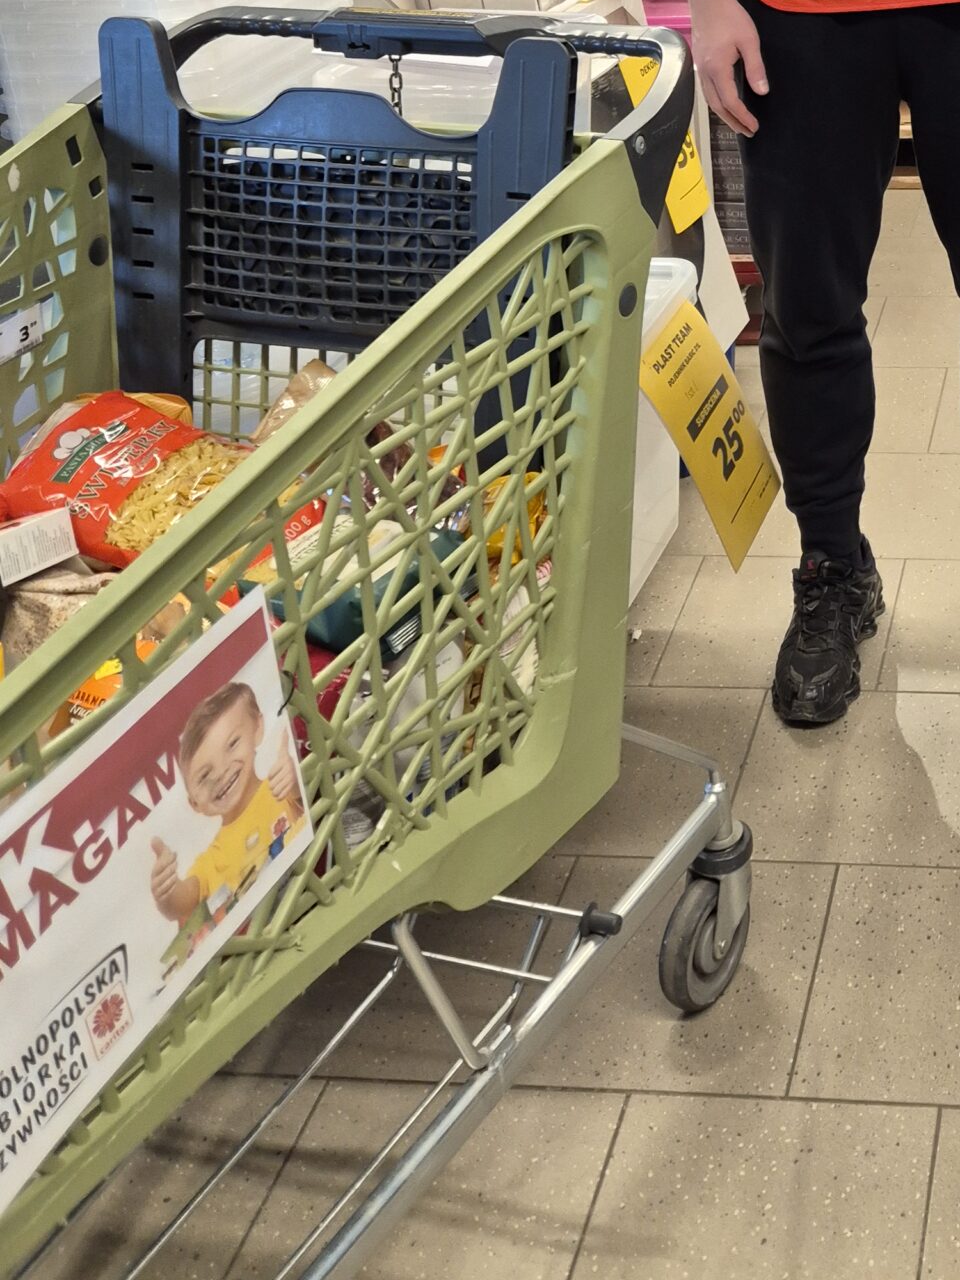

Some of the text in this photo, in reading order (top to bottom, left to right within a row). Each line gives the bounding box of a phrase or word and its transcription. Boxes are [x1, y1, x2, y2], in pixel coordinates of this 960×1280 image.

[652, 322, 693, 375] PLAST TEAM
[695, 389, 721, 427] SUPERCENA
